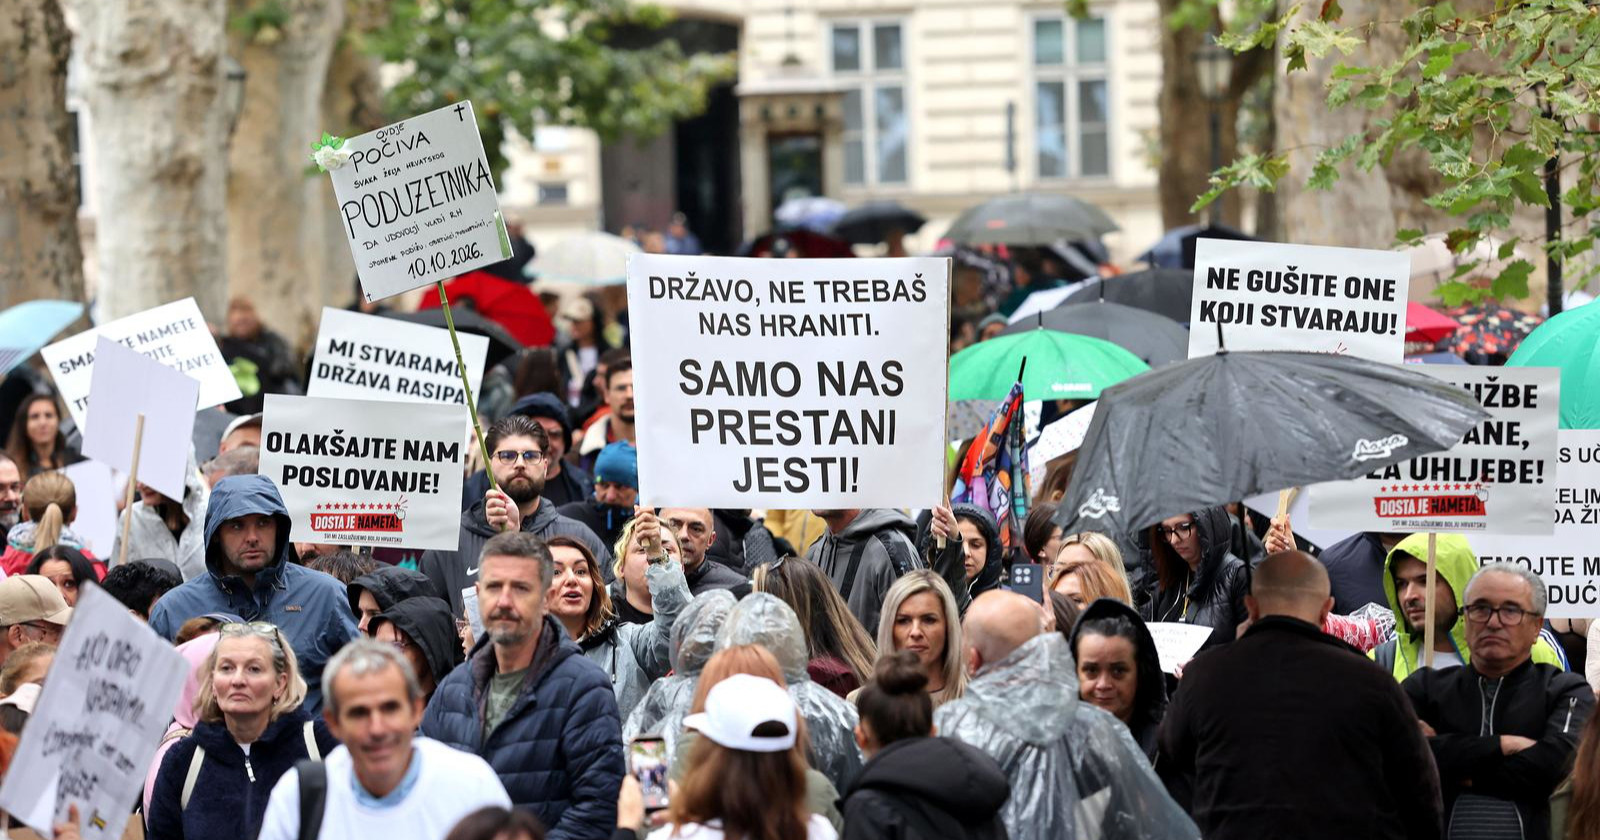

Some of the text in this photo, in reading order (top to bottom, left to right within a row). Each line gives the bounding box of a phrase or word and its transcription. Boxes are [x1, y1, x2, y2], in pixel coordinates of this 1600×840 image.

[375, 122, 405, 140] OVDJE
[349, 131, 431, 173] POČIVA
[353, 175, 378, 189] SVAKA
[406, 152, 445, 171] HRVATSKOG
[342, 157, 493, 239] PODUZETNIKA
[362, 239, 379, 251] DA
[450, 208, 463, 220] RH
[408, 242, 484, 280] 10.10.2026.
[648, 271, 928, 307] DRŽAVO, NE TREBAŠ
[1206, 265, 1396, 302] NE GUŠITE ONE
[137, 317, 197, 346] NAMETE
[698, 312, 880, 338] NAS HRANITI.
[1200, 300, 1398, 335] KOJI STVARAJU!
[328, 338, 467, 379] MI STVARAMO
[317, 362, 391, 392] DRŽAVA
[678, 358, 905, 398] SAMO NAS
[690, 408, 896, 446] PRESTANI
[266, 429, 459, 464] OLAKŠAJTE NAM
[282, 465, 440, 494] POSLOVANJE!
[732, 456, 859, 494] JESTI!
[1409, 457, 1545, 484] UHLJEBE!
[314, 515, 400, 531] DOSTA JE NAMETA!
[1379, 497, 1481, 516] DOSTA JE NAMETA!
